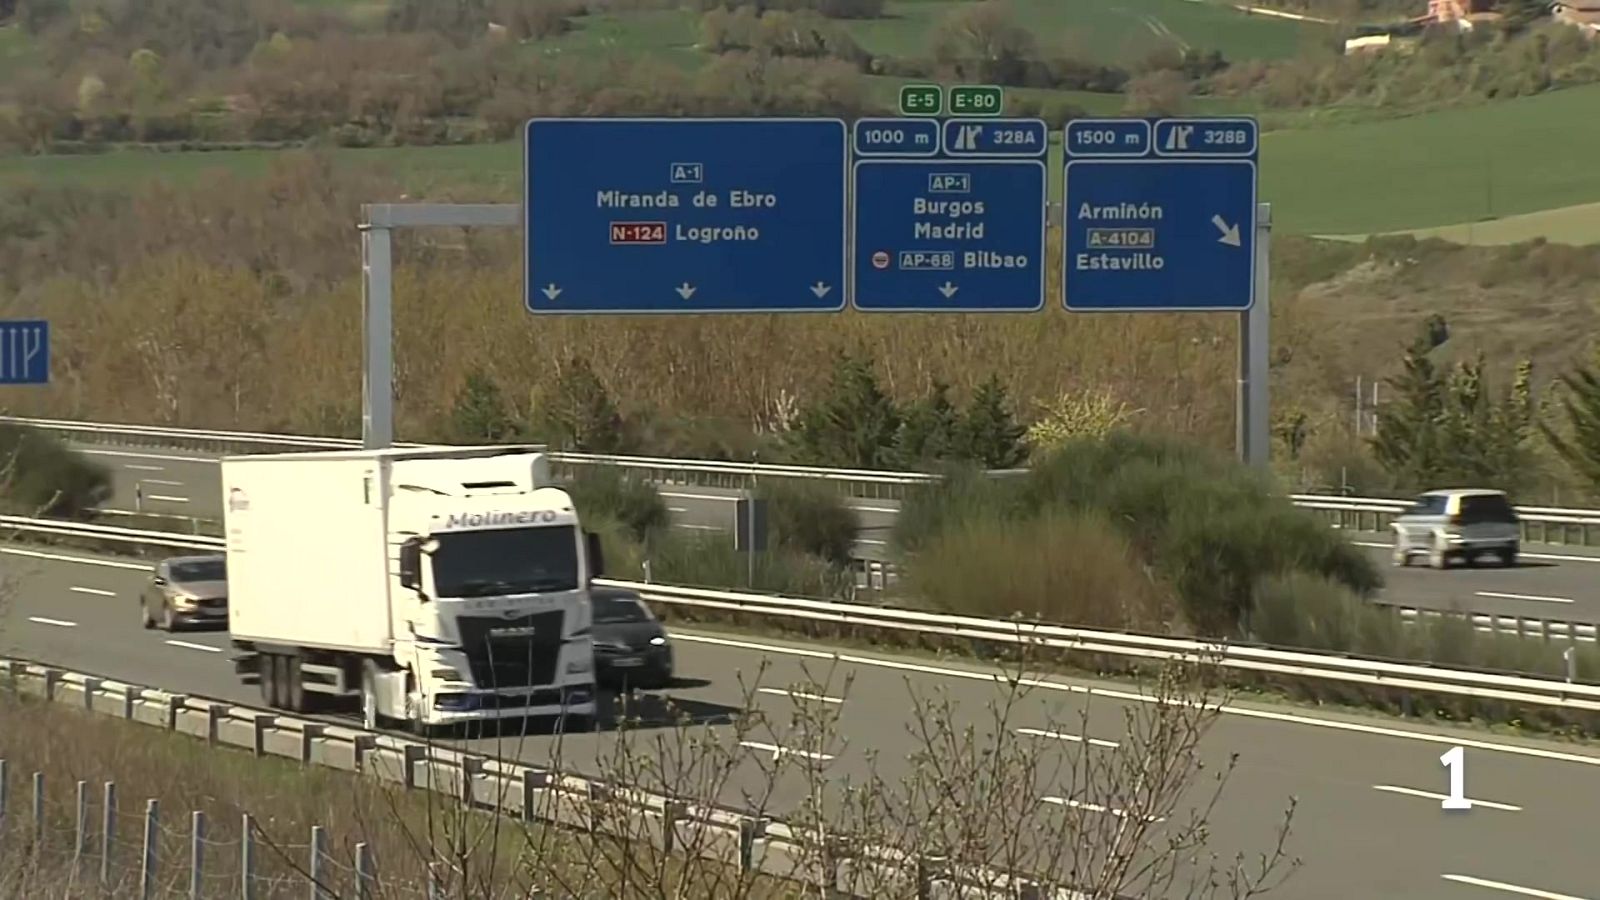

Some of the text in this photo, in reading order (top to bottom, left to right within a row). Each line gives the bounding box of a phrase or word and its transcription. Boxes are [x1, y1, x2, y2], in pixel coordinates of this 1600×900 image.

[907, 94, 934, 107] E-5
[955, 94, 995, 107] E-80
[865, 130, 929, 144] 1000 m
[994, 130, 1035, 144] 328A
[1076, 131, 1139, 145] 1500 m
[1204, 131, 1246, 144] 328B
[675, 166, 700, 179] A-1
[932, 176, 967, 190] AP-1
[597, 191, 776, 208] Miranda de Ebro
[914, 198, 984, 218] Burgos
[1078, 202, 1163, 220] Armiñón
[612, 224, 760, 243] N-124 Logroño
[914, 223, 983, 239] Madrid
[1090, 232, 1151, 245] A-4104
[903, 251, 1027, 268] AP-68 Bilbao
[1076, 254, 1164, 270] Estavillo
[446, 509, 557, 528] Molinero
